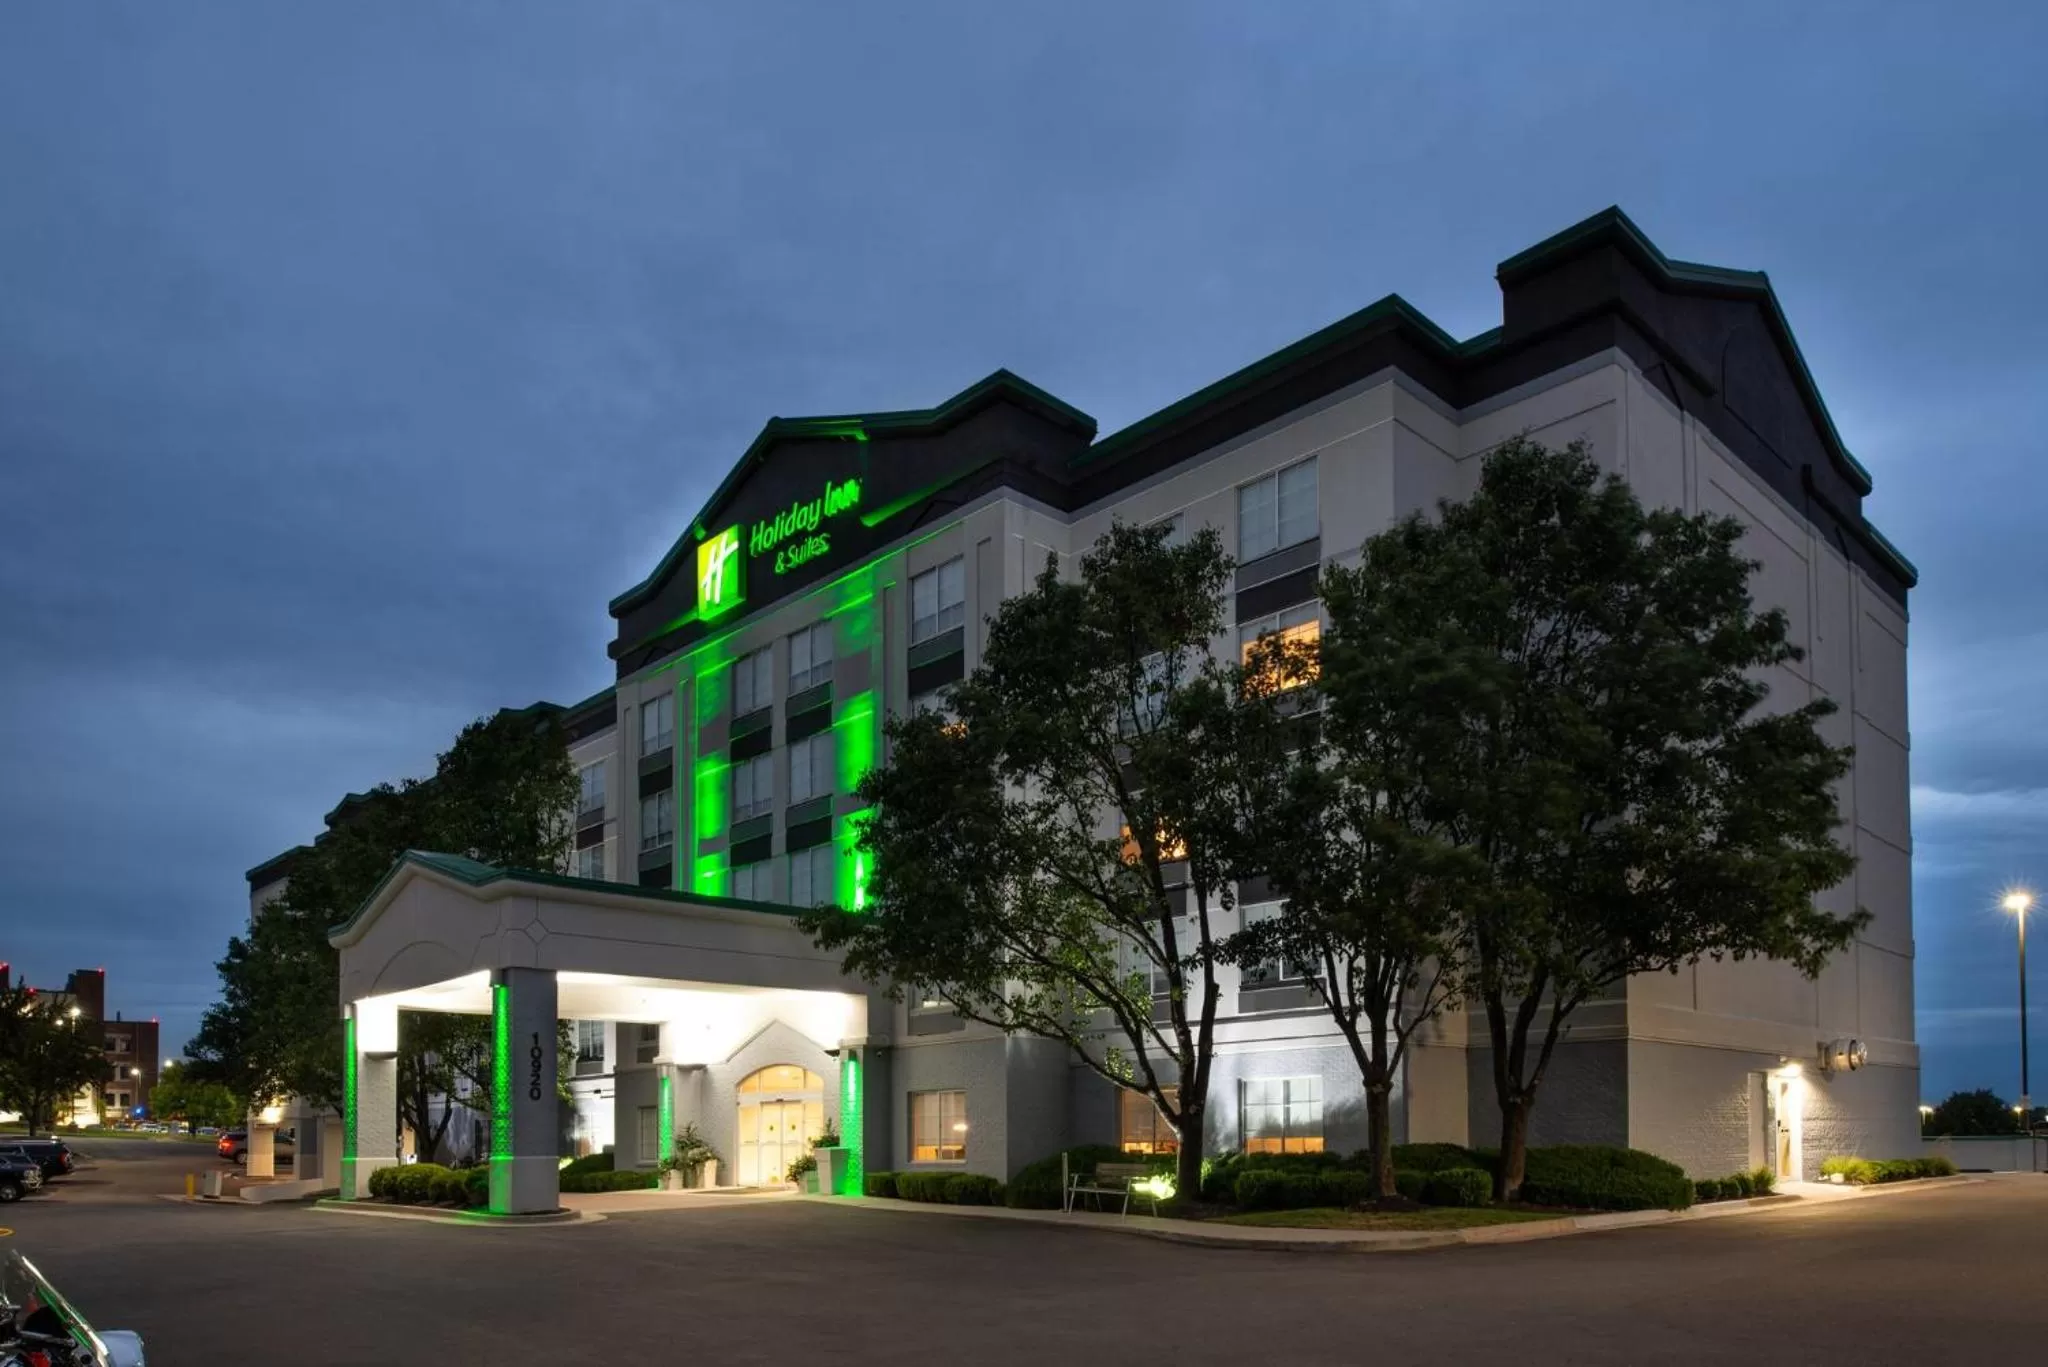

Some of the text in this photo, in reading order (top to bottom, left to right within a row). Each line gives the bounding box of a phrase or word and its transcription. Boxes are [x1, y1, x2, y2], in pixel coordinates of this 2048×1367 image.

[750, 480, 860, 557] Holiday Inn
[775, 533, 831, 574] & Suites
[529, 1031, 543, 1101] 10920
